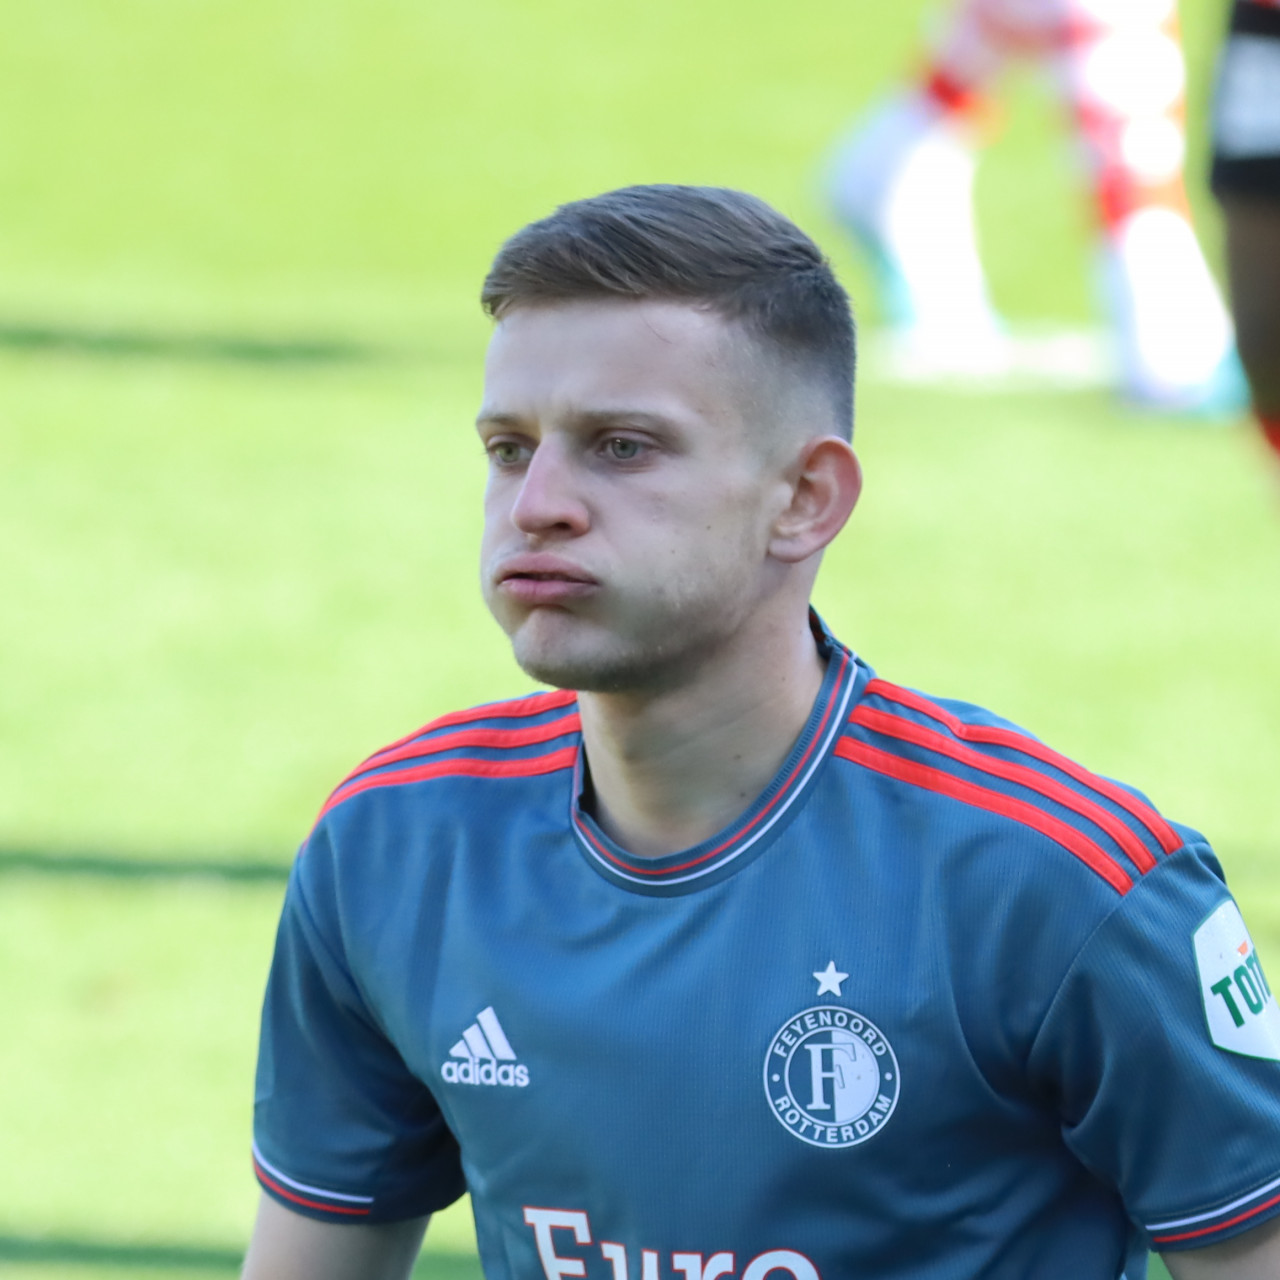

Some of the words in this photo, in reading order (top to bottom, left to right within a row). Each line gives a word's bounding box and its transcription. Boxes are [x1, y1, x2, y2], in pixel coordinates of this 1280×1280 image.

[773, 1010, 888, 1058] FEYENOORD
[440, 1056, 531, 1088] adidas
[803, 1042, 857, 1111] F
[774, 1093, 893, 1143] ROTTERDAM
